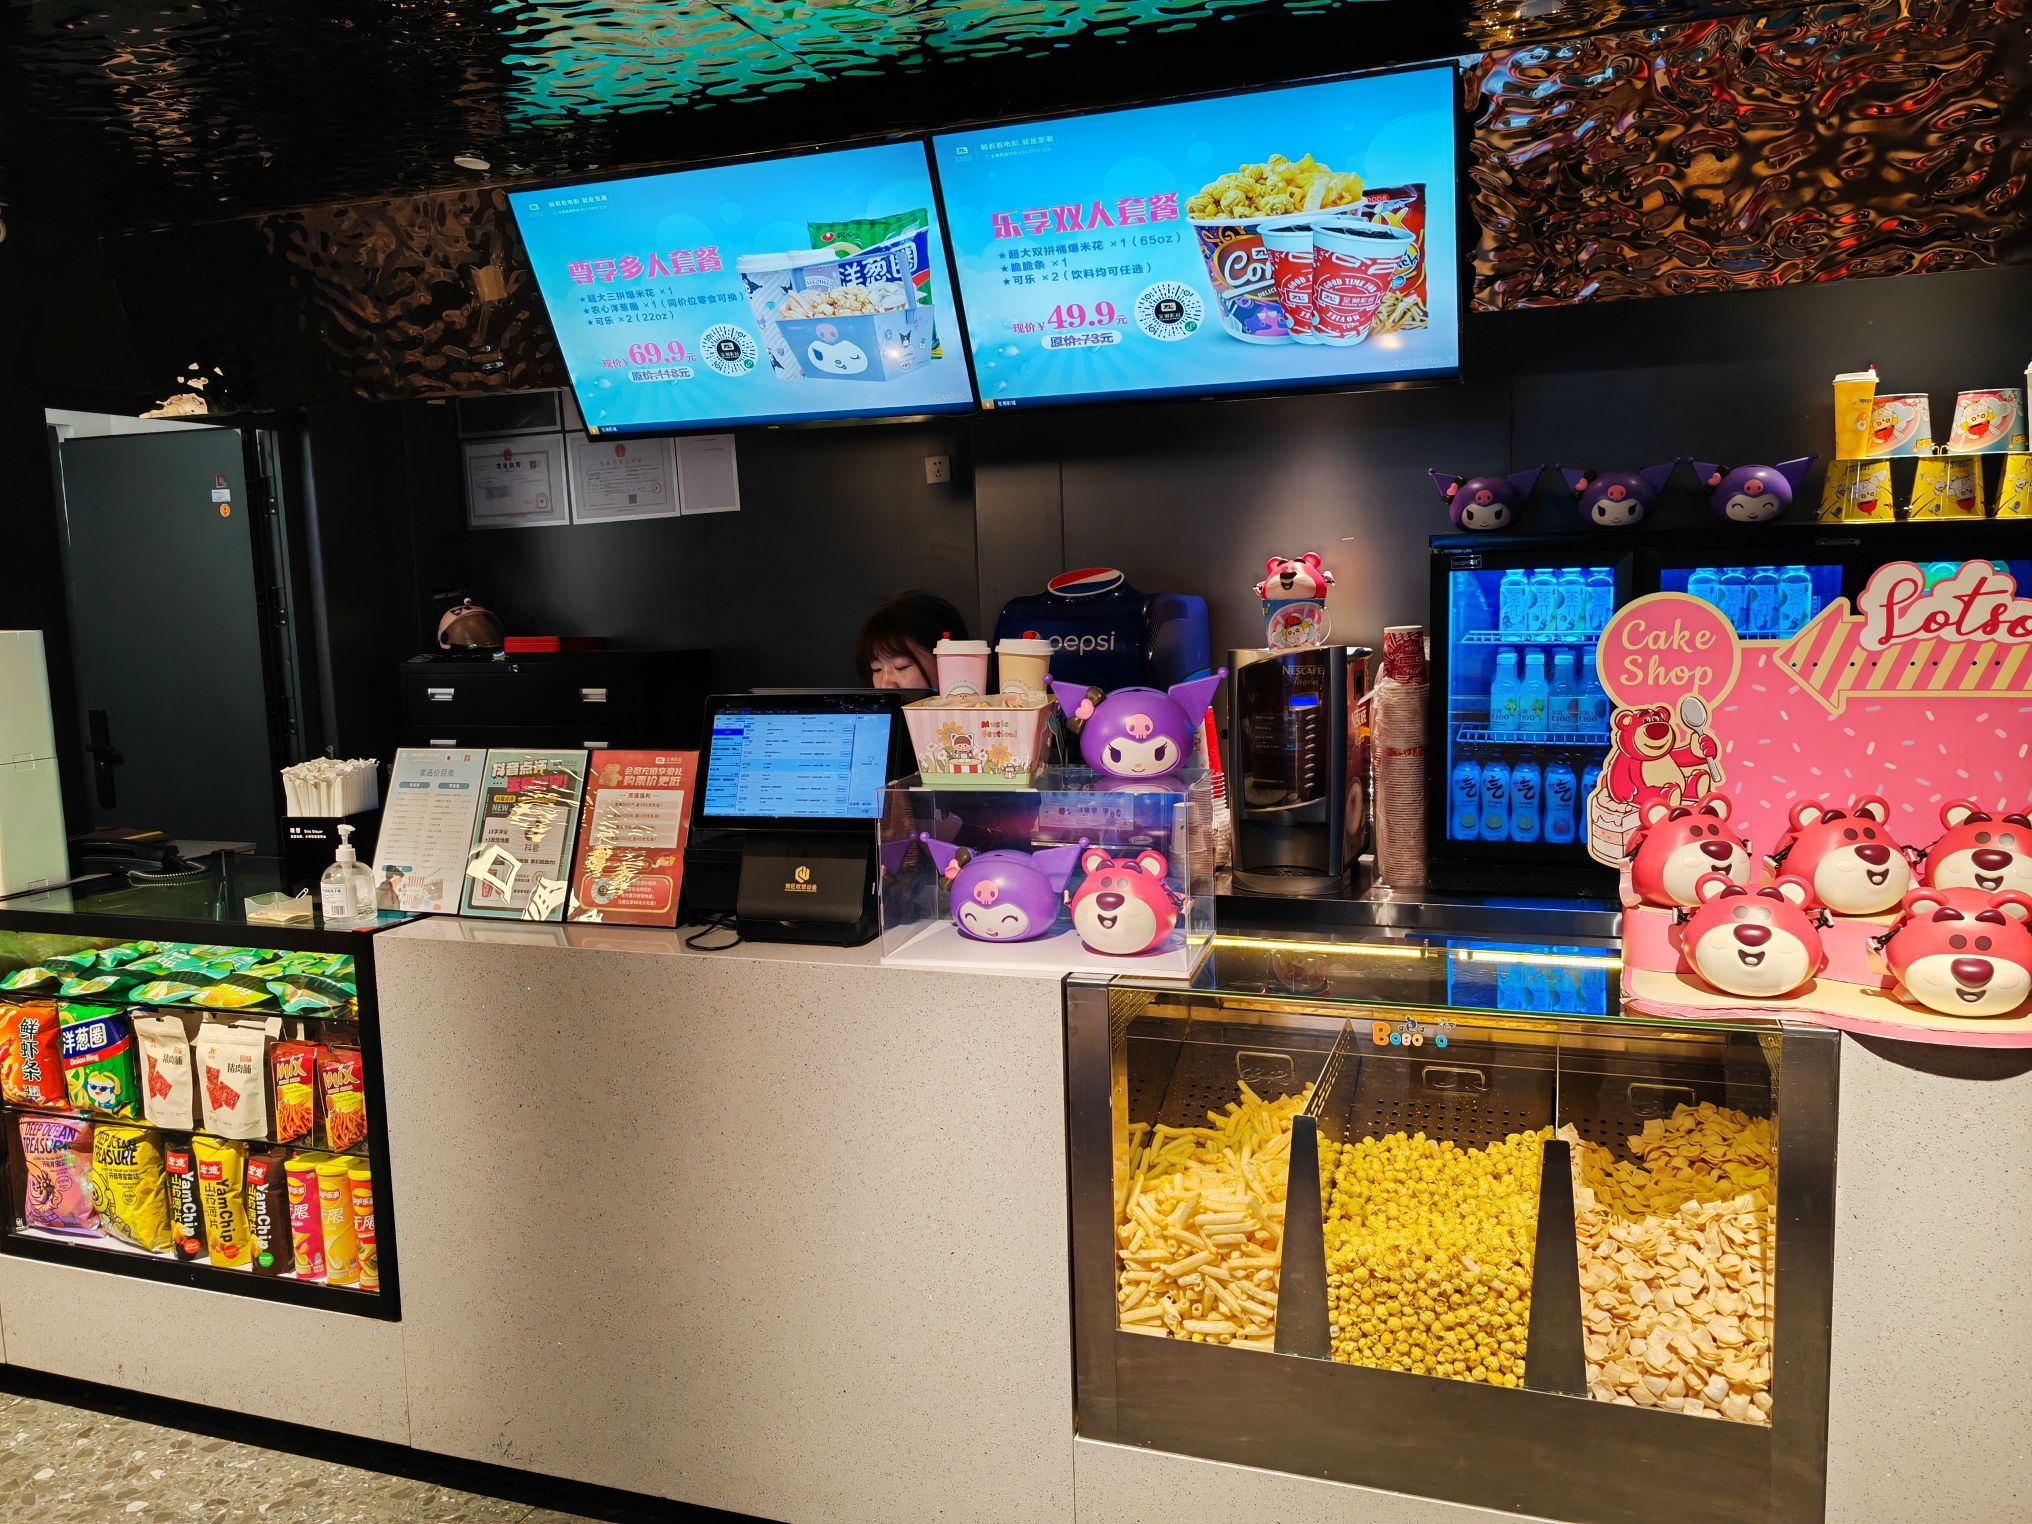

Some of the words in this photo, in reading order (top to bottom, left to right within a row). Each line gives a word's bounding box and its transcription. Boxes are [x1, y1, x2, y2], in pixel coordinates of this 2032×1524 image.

[991, 192, 1181, 240] 乐享双人套餐
[1008, 240, 1104, 260] 超大双拼桶爆米花
[567, 245, 724, 286] 尊享多人套餐
[1010, 258, 1046, 273] 脆脆条
[1013, 272, 1036, 286] 可乐
[1323, 278, 1343, 290] GOOD
[587, 288, 655, 303] 超大三拼爆米花
[591, 302, 640, 314] 农心洋葱圈
[594, 315, 615, 326] 可乐
[1621, 618, 1716, 653] Cake
[1619, 654, 1713, 696] Shop
[981, 720, 1010, 729] Music
[981, 729, 1018, 739] Festival
[492, 759, 548, 778] 抖音点评
[623, 775, 682, 787] 购票价更低
[492, 803, 509, 812] NEW
[63, 1022, 108, 1055] 洋葱圈
[18, 1017, 42, 1082] 鲜虾条
[70, 1055, 86, 1066] Onion
[86, 1053, 99, 1063] Ring
[277, 1056, 308, 1082] mix
[322, 1064, 361, 1089] mix
[25, 1122, 43, 1137] DEEP
[181, 1170, 199, 1237] YamChip
[215, 1177, 236, 1243] YamChip
[256, 1183, 272, 1250] YamChip
